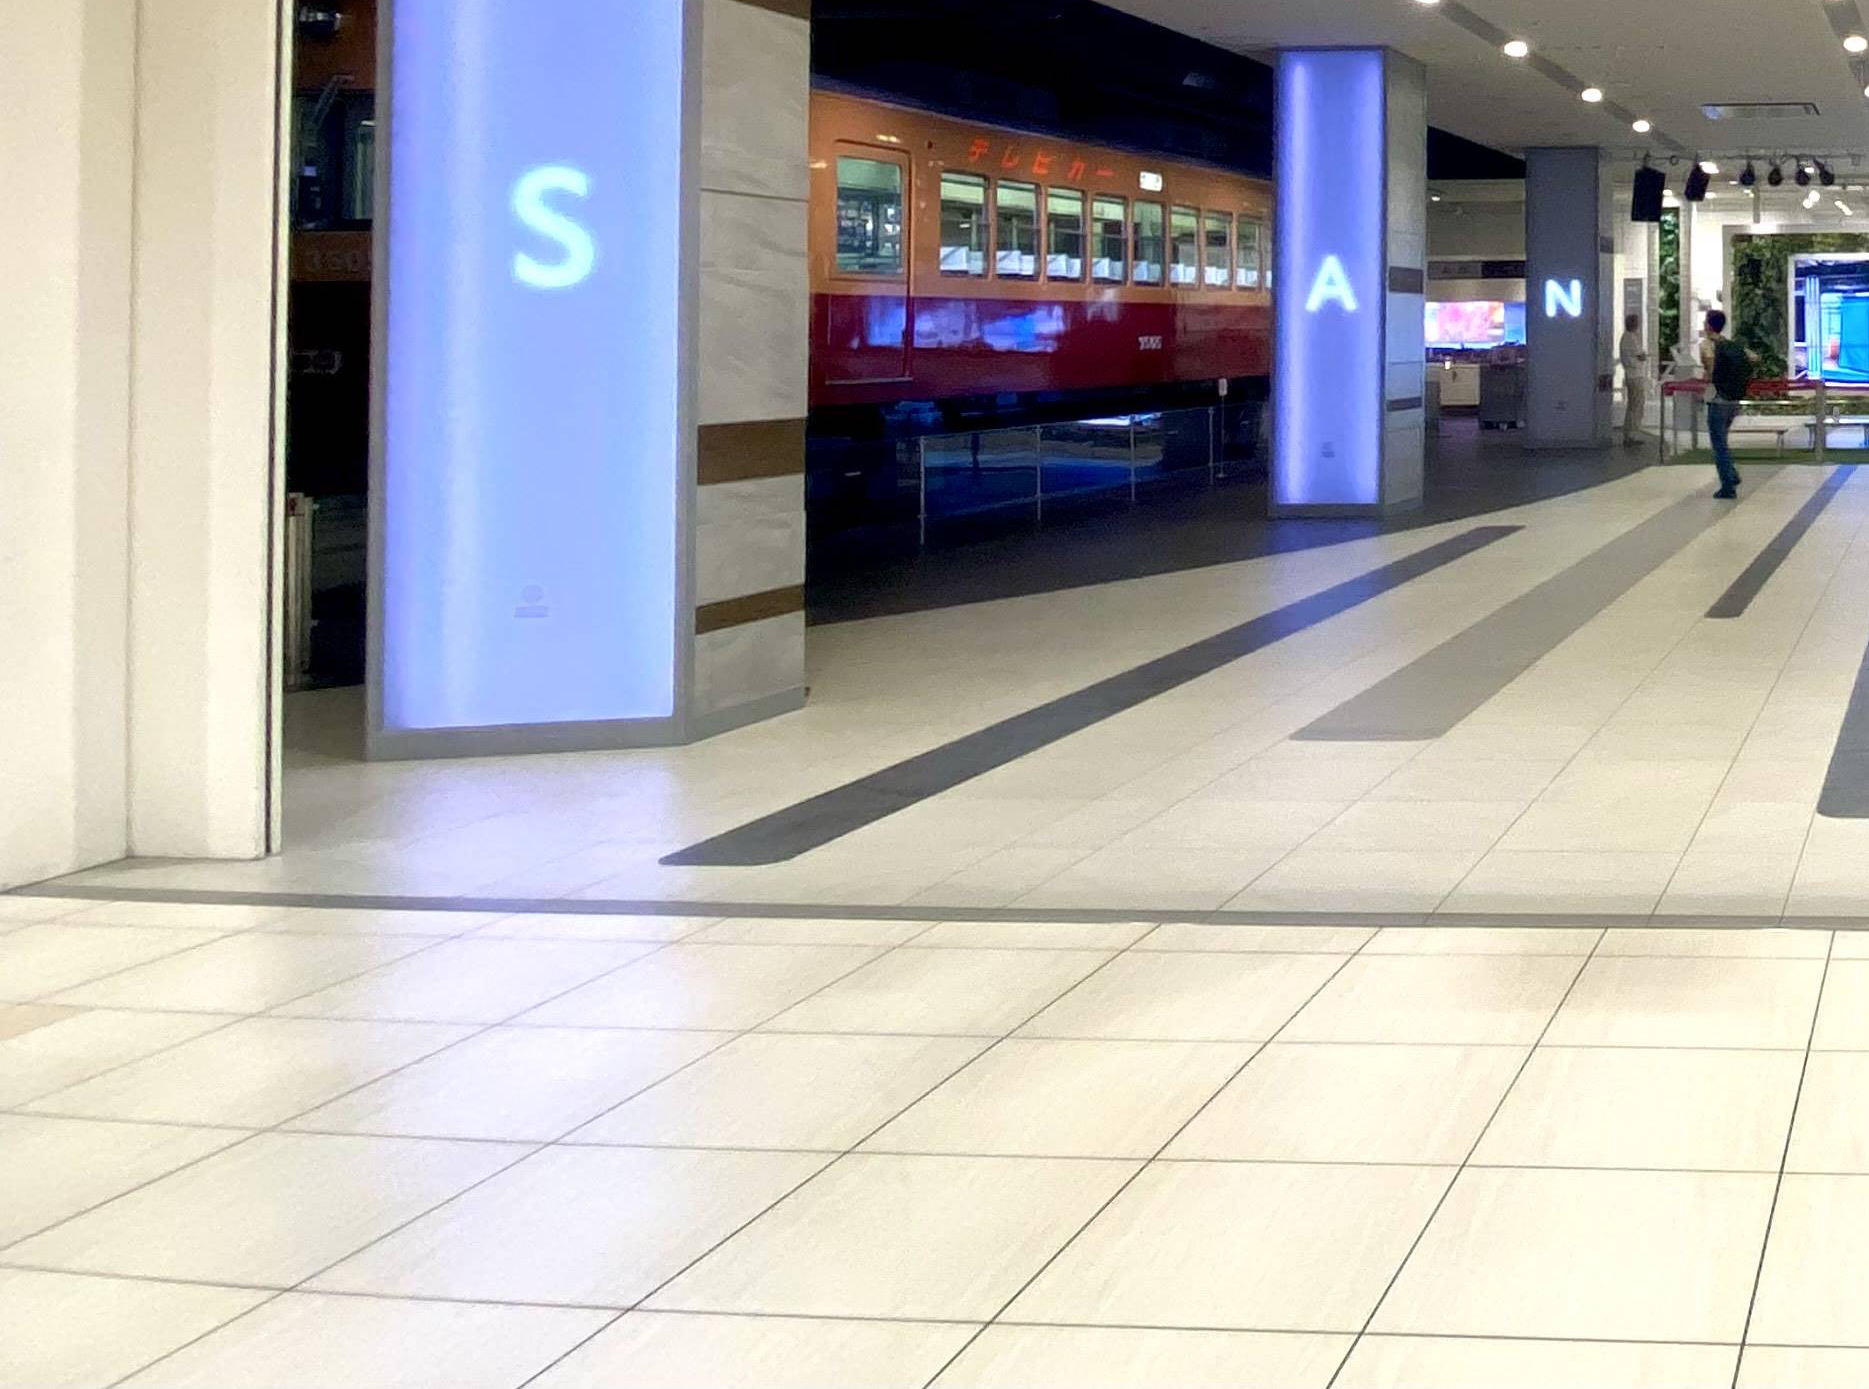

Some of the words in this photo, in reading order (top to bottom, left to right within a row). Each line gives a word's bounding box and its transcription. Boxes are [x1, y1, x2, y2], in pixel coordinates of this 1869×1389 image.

[969, 136, 1116, 183] テレビカー
[512, 165, 595, 288] S
[1305, 255, 1358, 312] A
[1544, 278, 1582, 318] N
